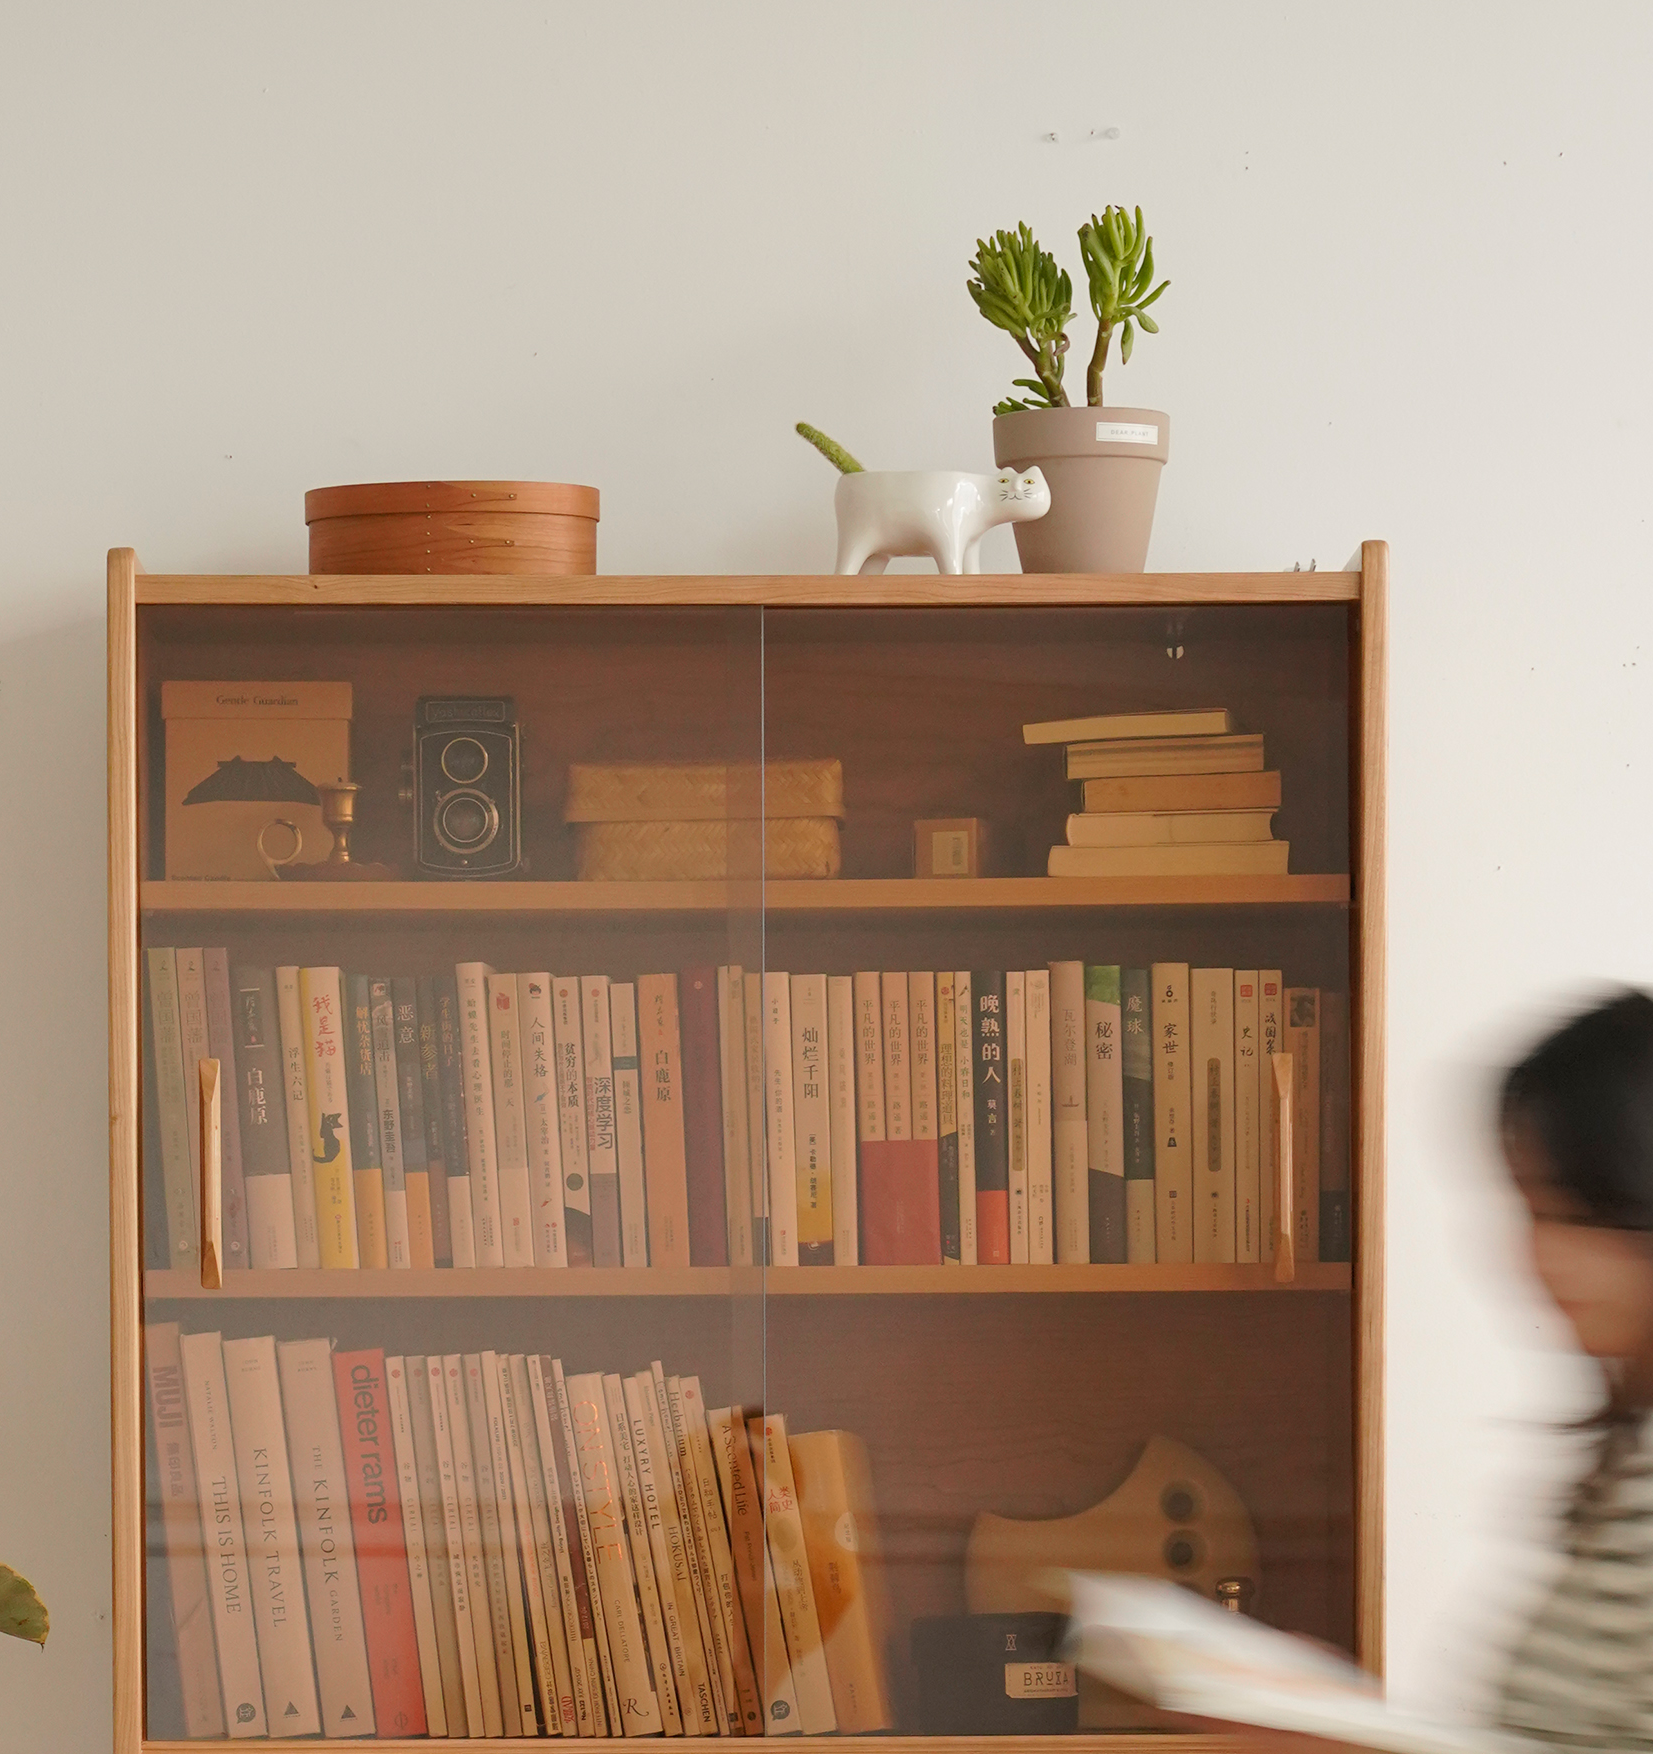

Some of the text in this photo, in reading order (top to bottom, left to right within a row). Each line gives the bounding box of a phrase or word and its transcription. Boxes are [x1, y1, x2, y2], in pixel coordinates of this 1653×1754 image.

[216, 694, 298, 706] Gentle Guardian
[312, 994, 337, 1058] 我是猫
[355, 1006, 373, 1076] 解忧杂货店
[397, 1004, 415, 1044] 恶意
[863, 1000, 876, 1065] 平凡的世界
[889, 1000, 903, 1066] 平凡的世界
[916, 1000, 929, 1065] 平凡的世界
[980, 996, 1002, 1084] 晚熟的人
[1064, 1009, 1078, 1066] 瓦尔登湖
[1095, 1021, 1113, 1060] 秘密
[1126, 995, 1145, 1035] 魔球
[1162, 1023, 1179, 1055] 家世
[1241, 1026, 1254, 1057] 史记
[287, 1046, 305, 1102] 浮生六记
[419, 1024, 438, 1081] 新参者
[465, 998, 485, 1116] 蛤蟆先生去看心理医生
[500, 1030, 515, 1108] 时间停止的那一天
[530, 1017, 549, 1077] 人间失格
[564, 1042, 579, 1108] 贫穷的本质
[655, 1050, 671, 1102] 白鹿原
[802, 1027, 819, 1099] 灿烂千阳
[247, 1067, 268, 1126] 白鹿原
[593, 1077, 614, 1150] 深度学习
[622, 1081, 632, 1115] 倾城之恋
[941, 1043, 954, 1126] 理想的料理道具
[987, 1099, 998, 1124] 莫言
[382, 1108, 396, 1154] 东野圭吾
[152, 1365, 184, 1428] MUJI
[204, 1380, 218, 1451] NATALIE WALTON
[573, 1400, 604, 1453] ON
[667, 1391, 687, 1457] Herbarium
[350, 1363, 387, 1525] dieter rams
[633, 1419, 662, 1530] LUXYRY HOTEL
[723, 1425, 748, 1516] A Scented Life
[407, 1498, 416, 1533] CEREAL
[447, 1495, 457, 1531] CEREAL
[465, 1496, 474, 1532] CEREAL
[582, 1461, 624, 1565] STYLE
[768, 1486, 792, 1499] 人类
[769, 1500, 793, 1513] 简史
[212, 1476, 242, 1614] THIS IS HOME
[253, 1447, 287, 1628] KINFOLK TRAVEL
[312, 1445, 343, 1642] THE KINFOLK GARDEN
[668, 1525, 687, 1581] HOKUSAI
[614, 1600, 630, 1662] CARL DELLATORE
[667, 1602, 686, 1677] IN GREAT BRITAIN
[587, 1657, 603, 1728] INTERIOR DESIGN CHINA
[698, 1683, 711, 1723] TASCHEN
